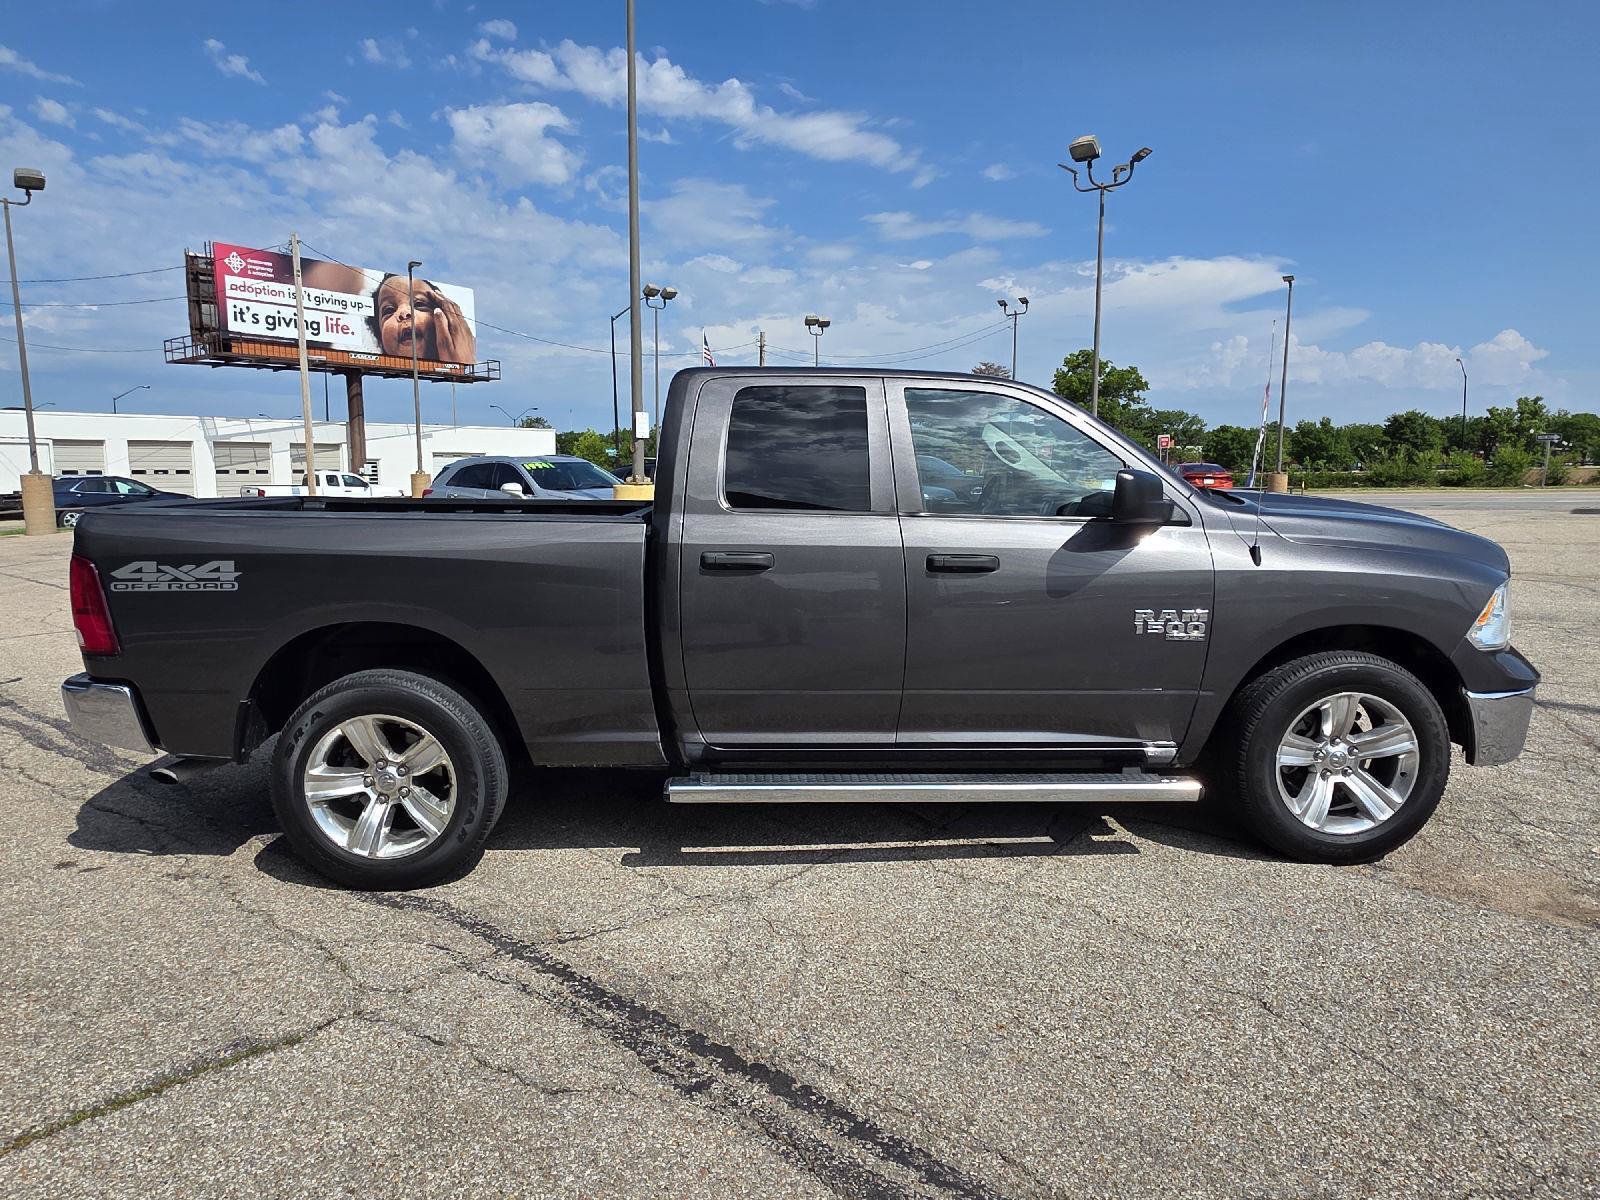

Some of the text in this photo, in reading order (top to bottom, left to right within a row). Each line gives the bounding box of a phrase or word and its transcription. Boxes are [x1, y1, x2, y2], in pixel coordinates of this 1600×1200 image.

[230, 281, 286, 298] adoption
[288, 287, 313, 303] is't
[314, 294, 349, 309] giving
[233, 304, 356, 336] it's giving life.
[113, 583, 236, 591] OFF ROAD
[1134, 609, 1209, 622] RAM
[1134, 621, 1206, 635] 1500
